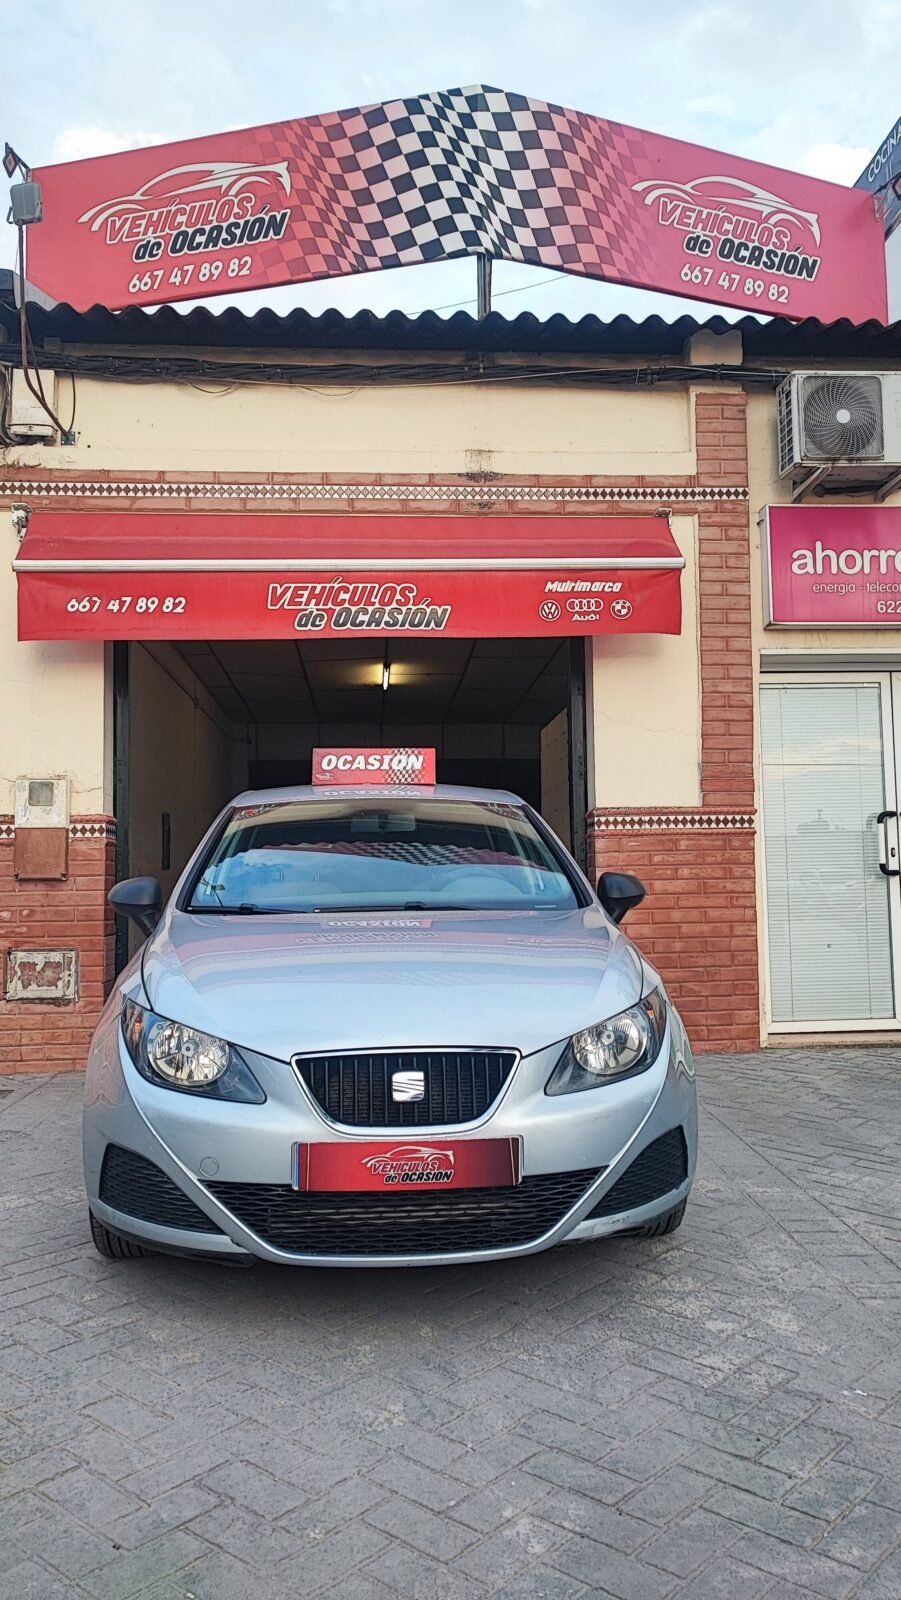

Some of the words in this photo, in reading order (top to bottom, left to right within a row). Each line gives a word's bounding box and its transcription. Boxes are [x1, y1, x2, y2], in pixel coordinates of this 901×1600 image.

[106, 193, 255, 244] VEHÍCULOS
[132, 237, 164, 263] de
[167, 205, 291, 256] OCASIÓN
[658, 197, 791, 251] VEHÍCULOS
[128, 270, 164, 293] 667
[168, 265, 194, 286] 47
[198, 260, 223, 281] 89
[227, 256, 251, 277] 82
[683, 232, 713, 256] de
[718, 236, 821, 282] OCASIÓN
[680, 263, 713, 286] 667
[718, 271, 740, 292] 47
[744, 277, 764, 298] 89
[768, 284, 789, 304] 82
[791, 540, 901, 575] ahorr
[268, 576, 417, 610] VEHÍCULOS
[866, 581, 901, 592] teleco
[66, 596, 101, 613] 667
[107, 596, 132, 613] 47
[135, 596, 159, 613] 89
[162, 596, 186, 613] 82
[294, 608, 328, 631] de
[331, 598, 451, 631] OCASIÓN
[572, 613, 600, 621] Audi
[384, 1174, 399, 1184] de
